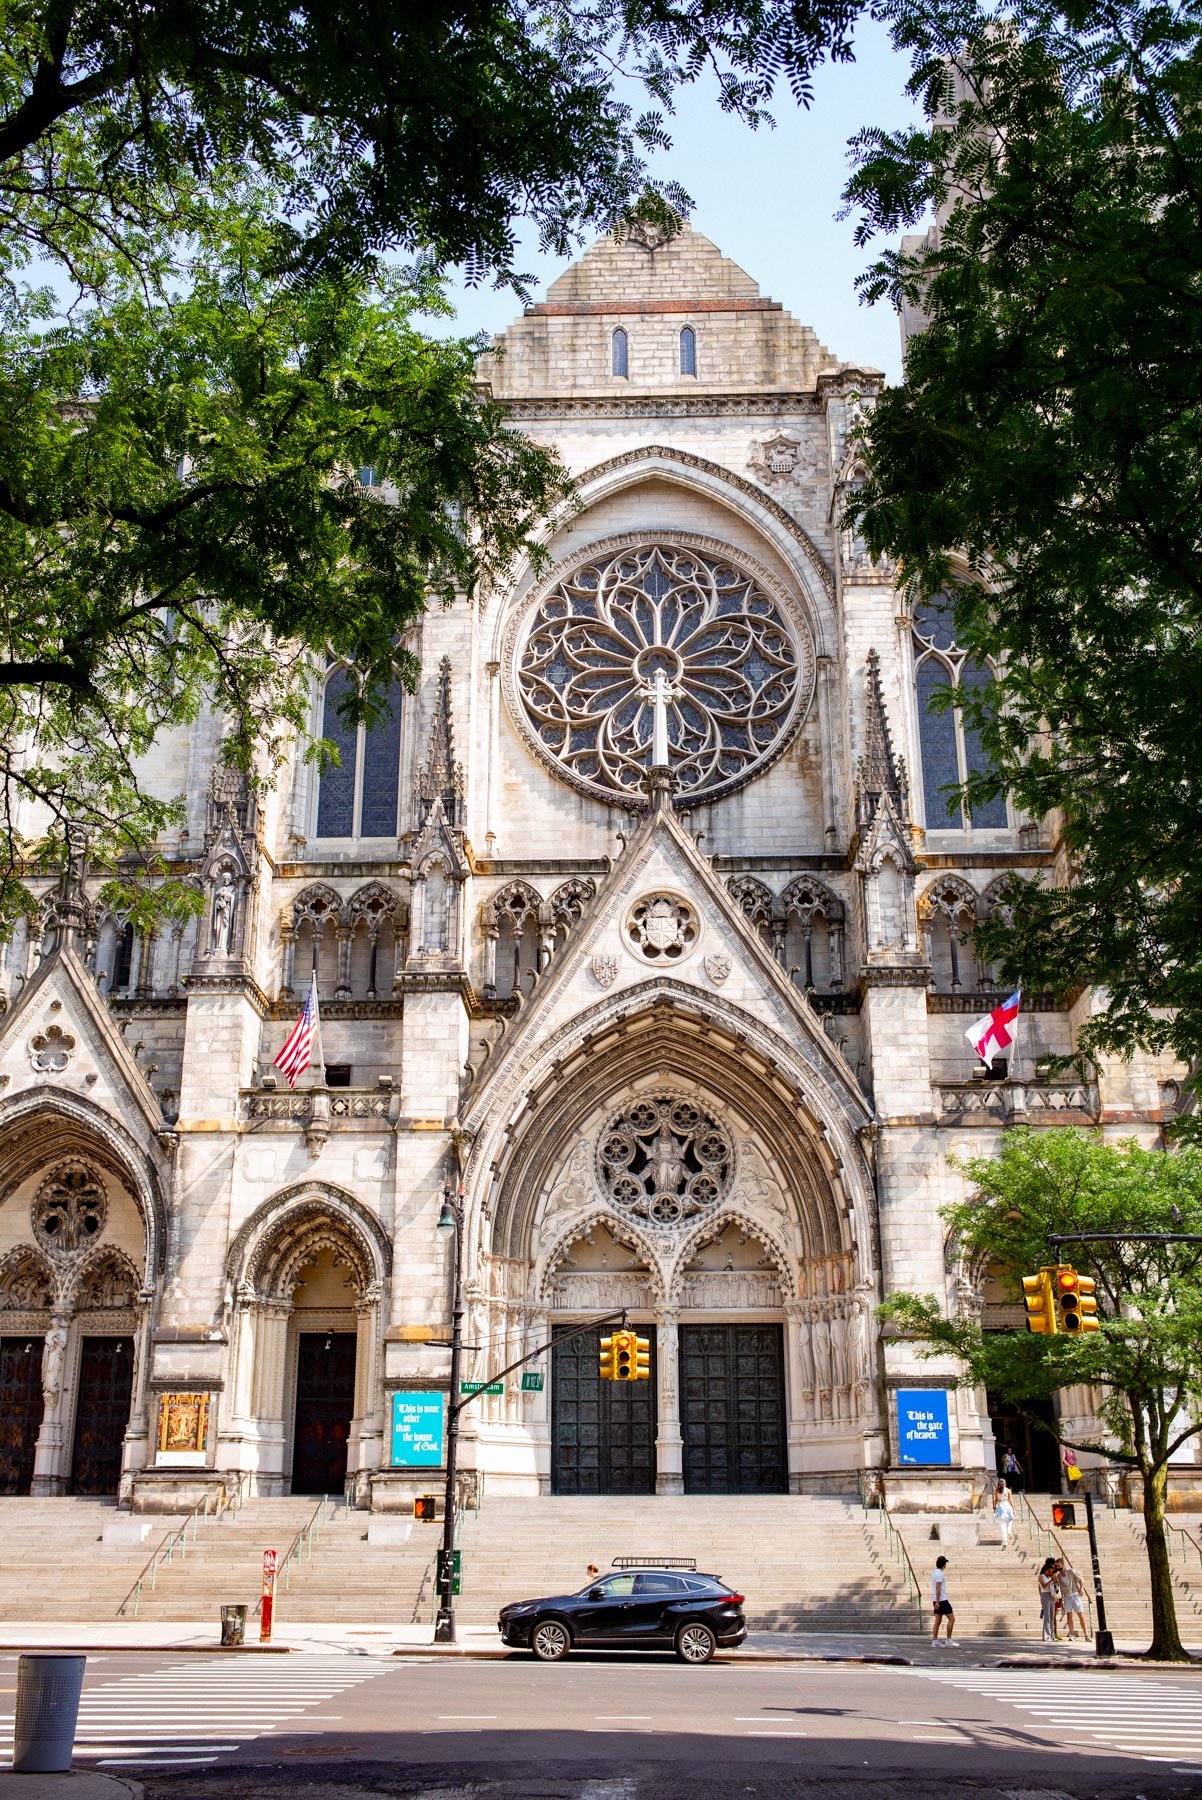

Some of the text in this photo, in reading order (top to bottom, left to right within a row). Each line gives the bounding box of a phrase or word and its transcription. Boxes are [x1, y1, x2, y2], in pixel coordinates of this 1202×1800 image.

[397, 1404, 440, 1413] This is none
[403, 1414, 420, 1422] other
[906, 1410, 934, 1420] This is
[396, 1423, 410, 1432] than
[917, 1421, 943, 1431] the gate
[402, 1433, 432, 1442] the house
[906, 1430, 938, 1440] of heaven.
[413, 1442, 439, 1452] of God.
